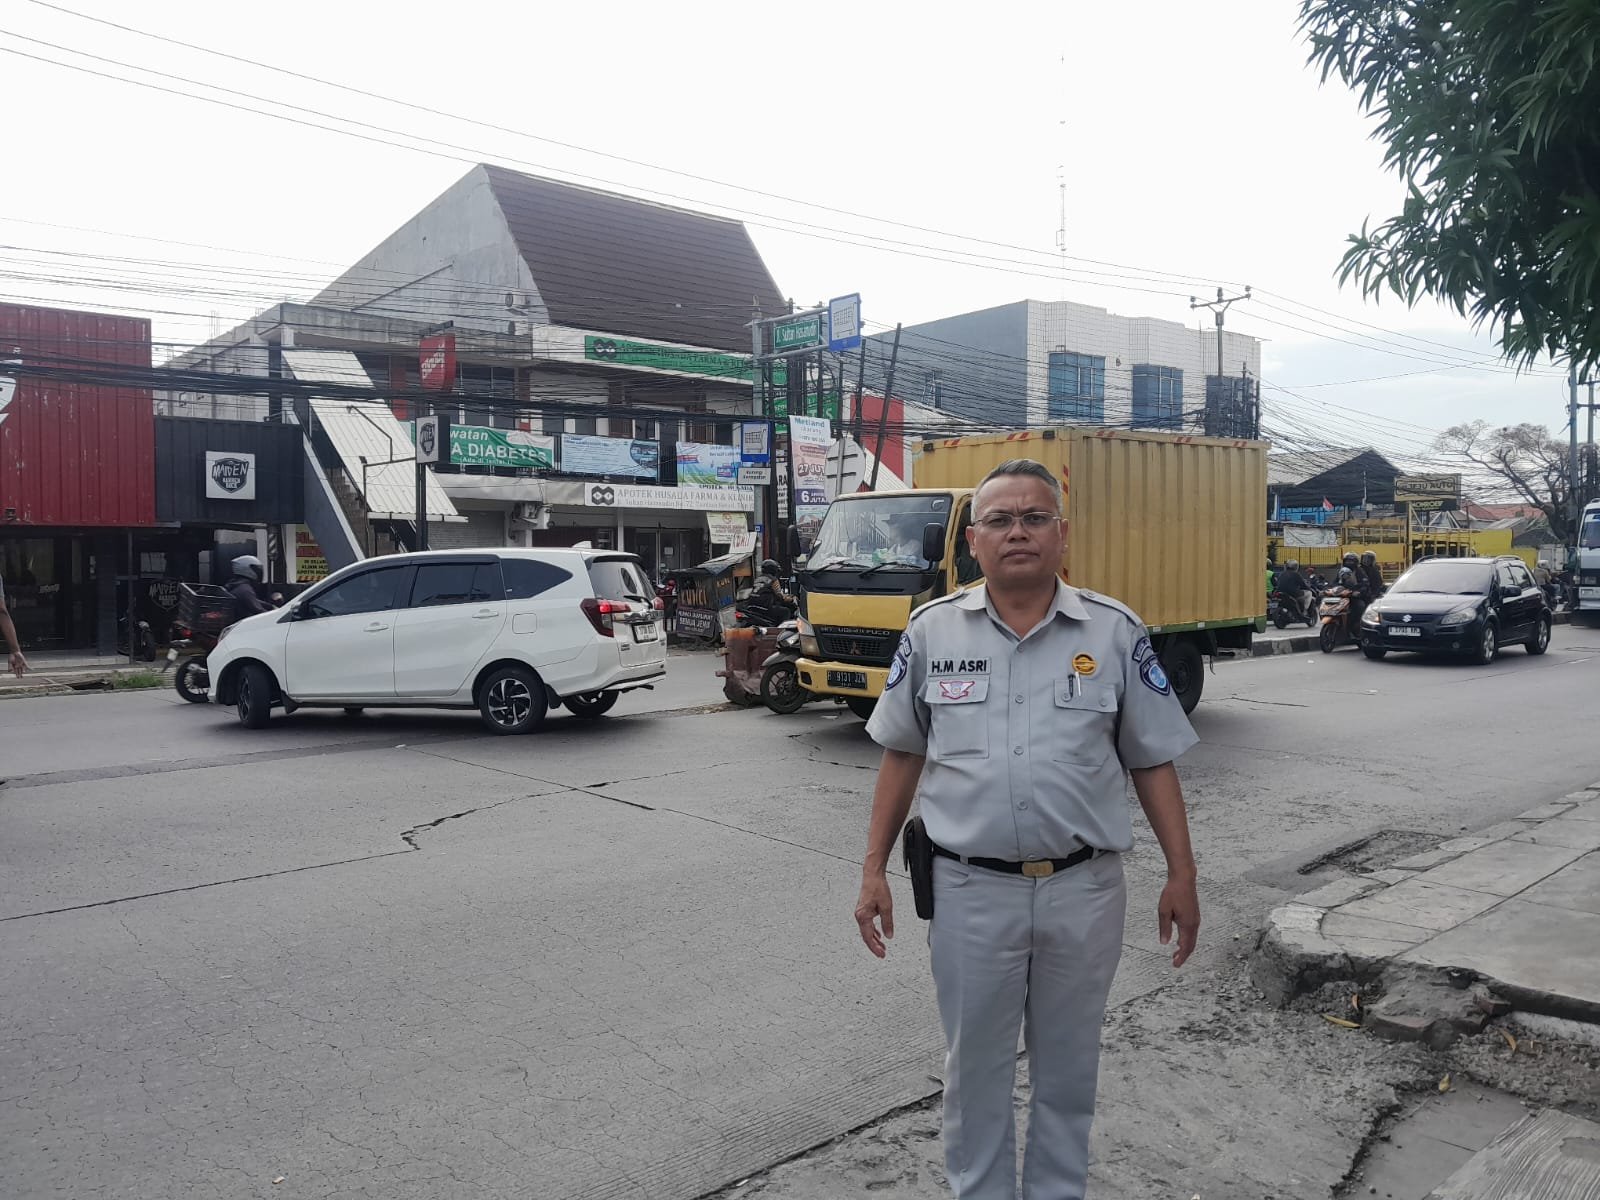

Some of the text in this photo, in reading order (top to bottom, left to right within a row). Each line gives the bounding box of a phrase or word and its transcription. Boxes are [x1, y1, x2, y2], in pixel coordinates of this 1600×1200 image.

[468, 443, 546, 461] DIABETES
[212, 462, 249, 480] MAIDEN
[618, 489, 652, 499] APOTEK
[690, 491, 718, 501] FARMA
[931, 659, 987, 673] H.M ASRI
